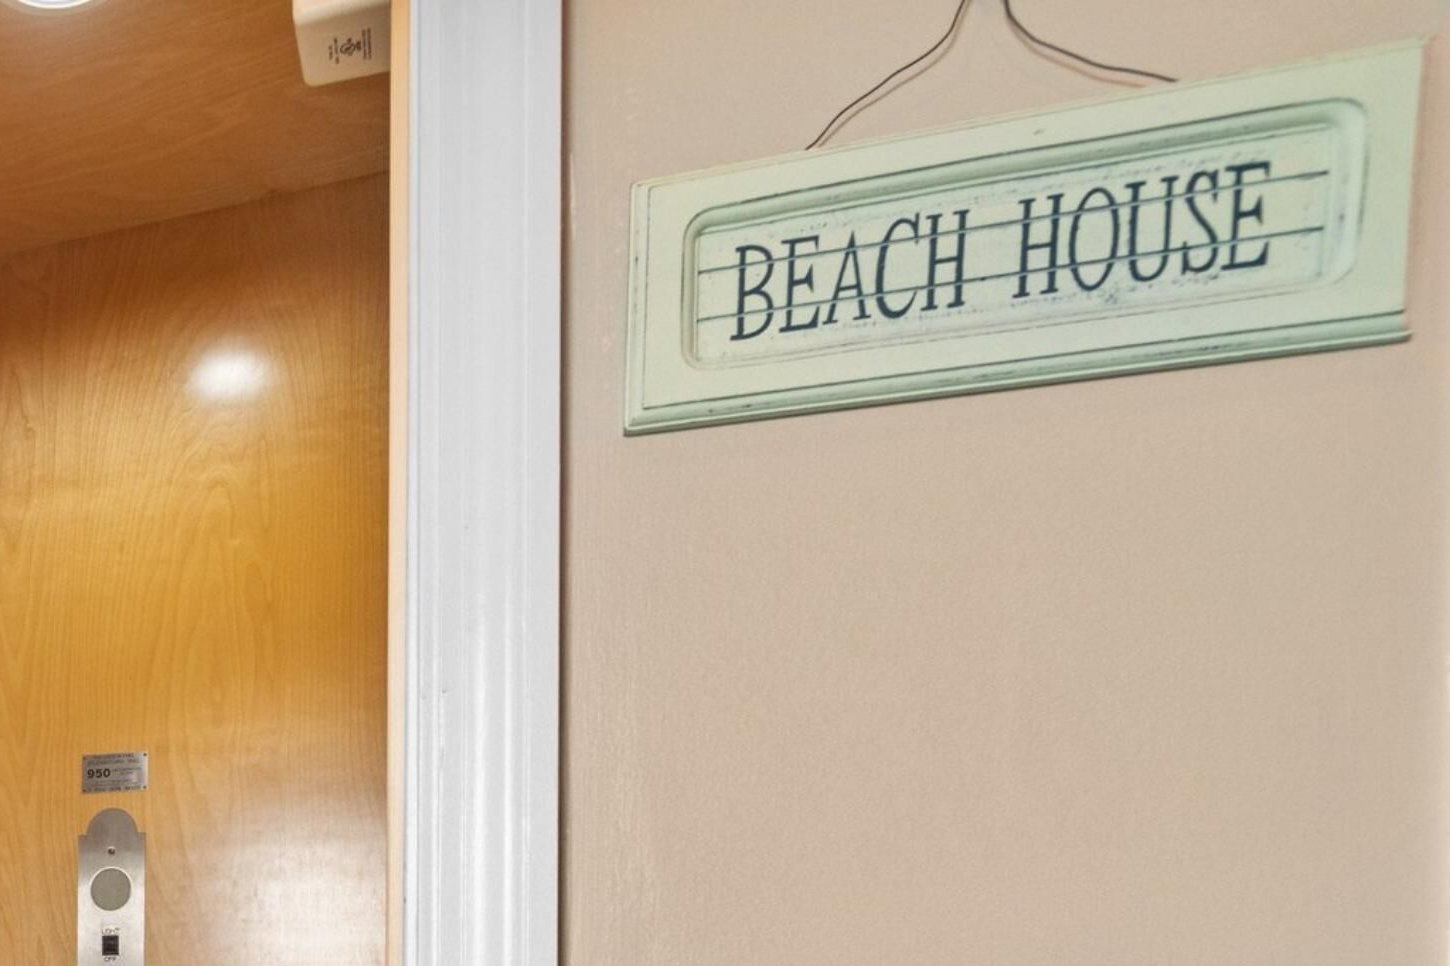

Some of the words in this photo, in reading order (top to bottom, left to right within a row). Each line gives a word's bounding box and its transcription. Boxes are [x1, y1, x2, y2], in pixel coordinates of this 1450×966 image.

[730, 209, 971, 341] BEACH
[1012, 162, 1271, 299] HOUSE
[87, 768, 110, 778] 950
